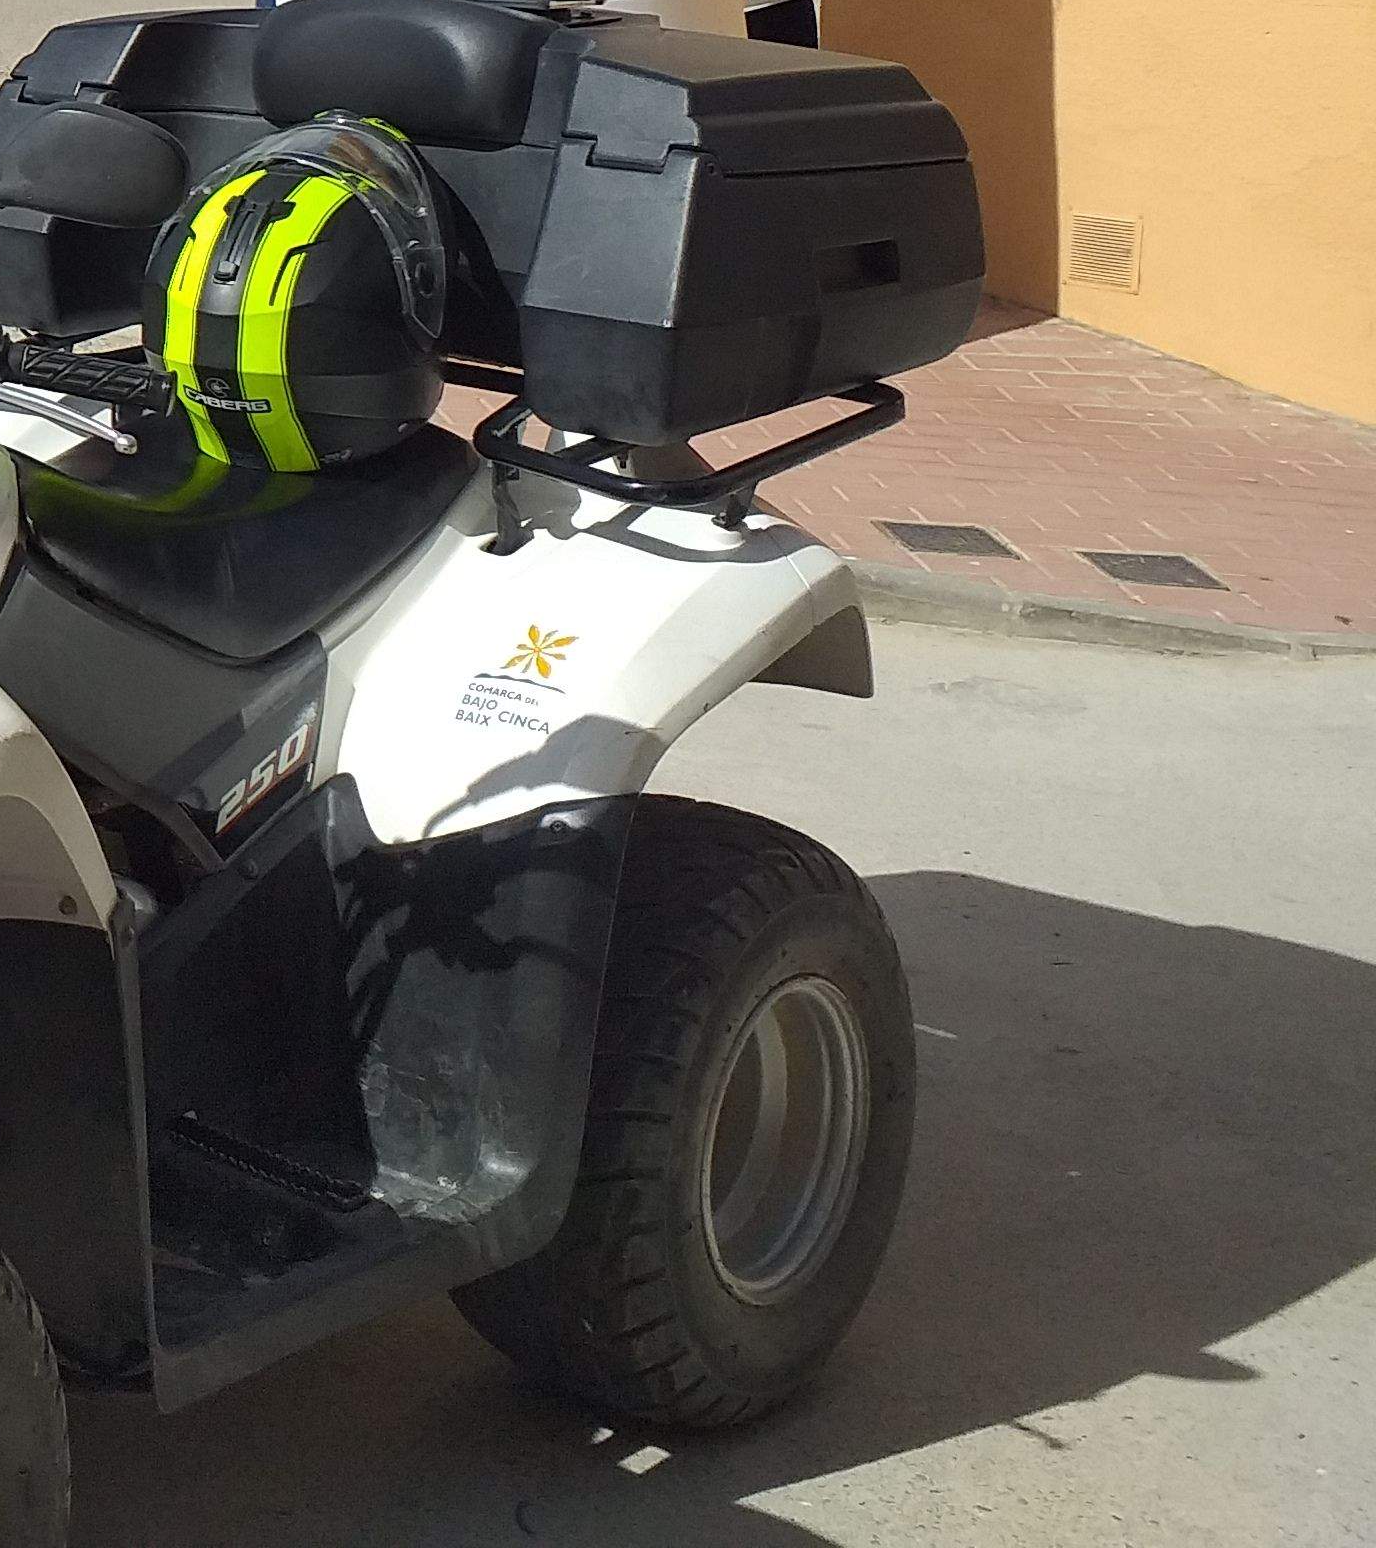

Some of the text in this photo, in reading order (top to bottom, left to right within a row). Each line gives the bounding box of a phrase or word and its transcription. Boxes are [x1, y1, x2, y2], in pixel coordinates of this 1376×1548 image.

[185, 387, 268, 411] CABERG
[468, 682, 522, 701] COMARCA
[455, 709, 491, 726] BAIX
[462, 694, 549, 734] BAJO CINCA
[215, 723, 308, 834] 250
